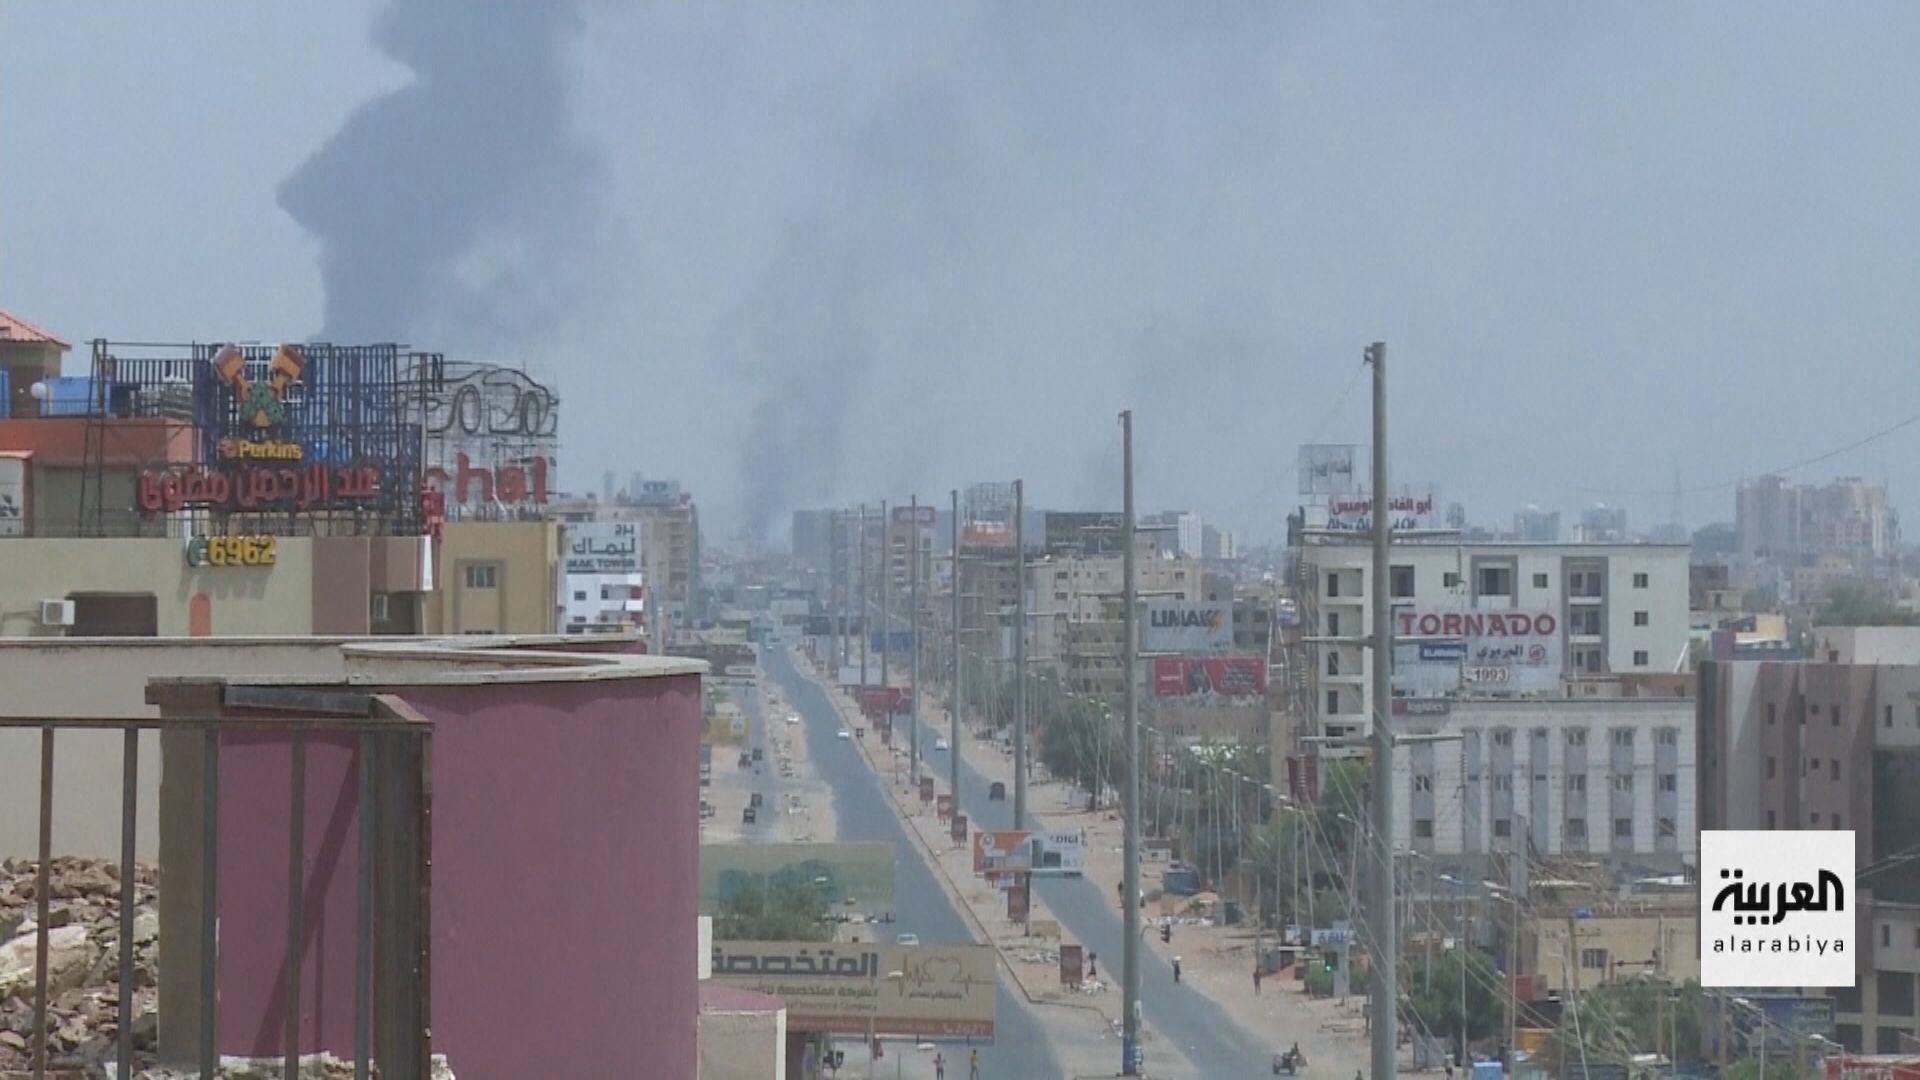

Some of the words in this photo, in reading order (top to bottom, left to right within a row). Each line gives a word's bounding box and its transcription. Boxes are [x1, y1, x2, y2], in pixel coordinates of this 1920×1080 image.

[239, 439, 303, 460] Perkins
[207, 534, 278, 566] 6962
[1398, 613, 1556, 637] TORNADO
